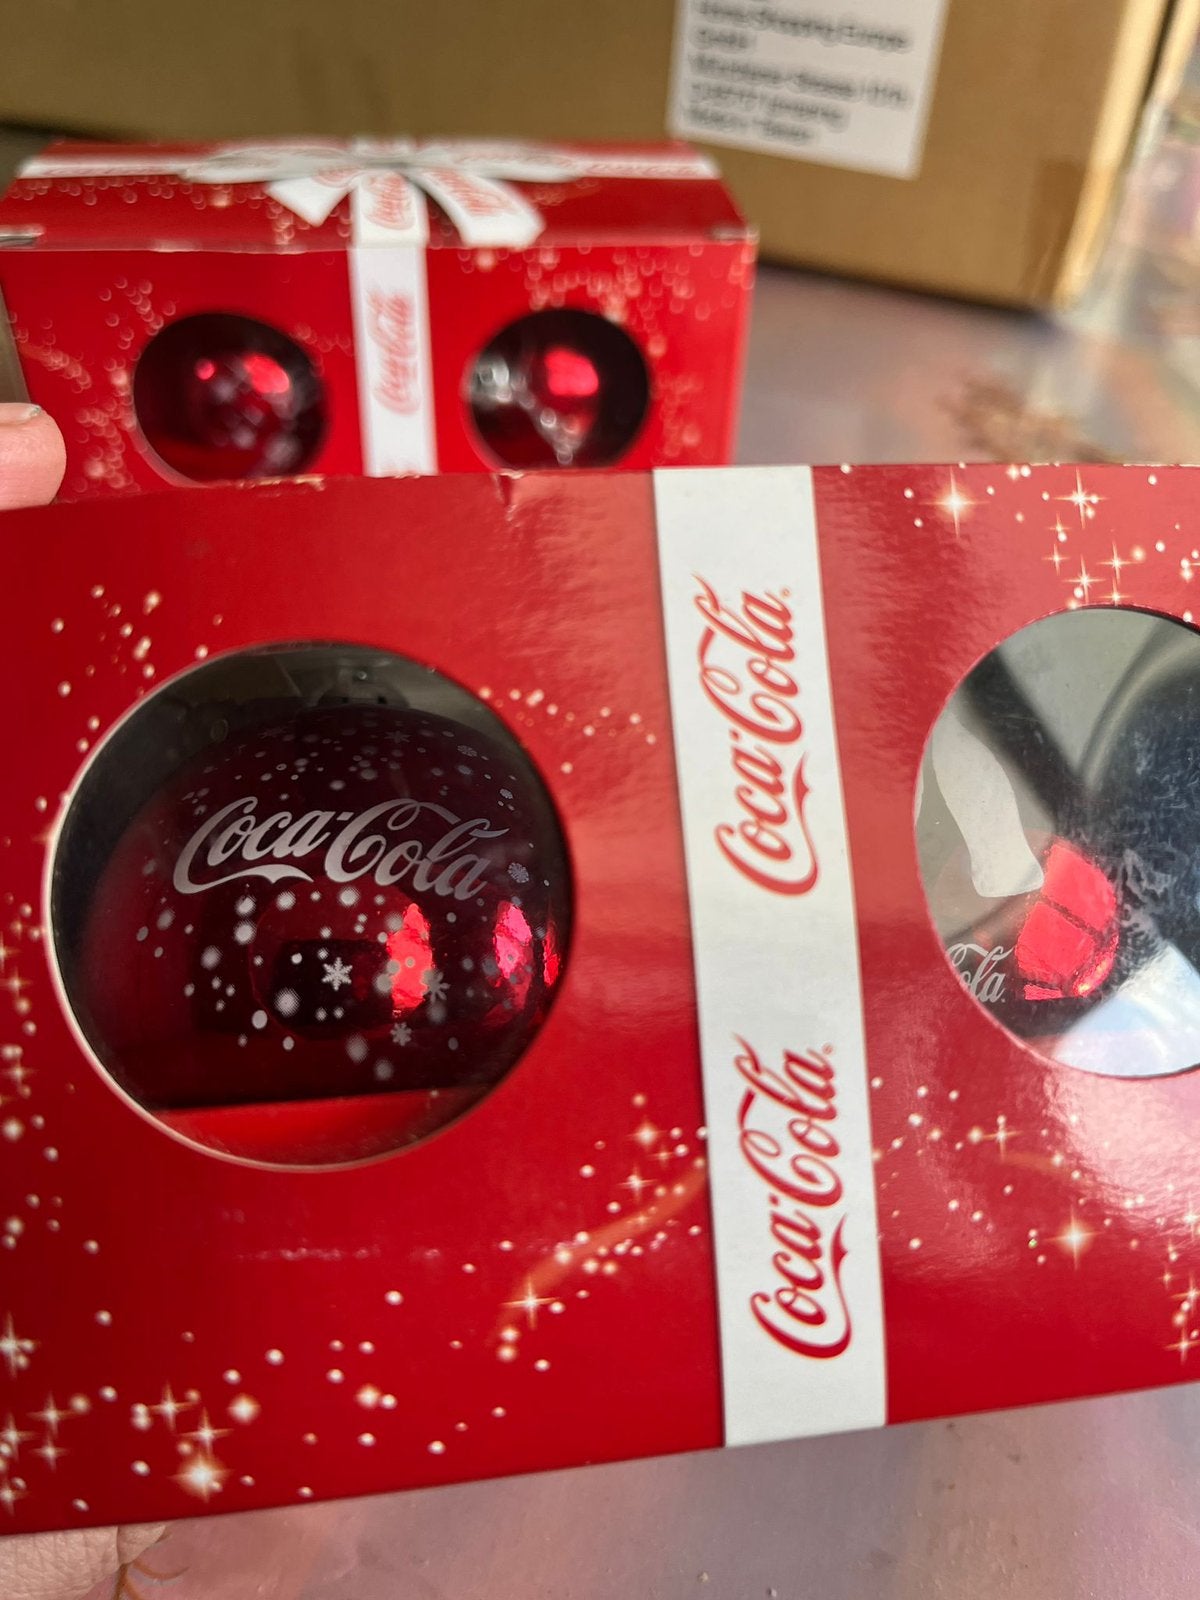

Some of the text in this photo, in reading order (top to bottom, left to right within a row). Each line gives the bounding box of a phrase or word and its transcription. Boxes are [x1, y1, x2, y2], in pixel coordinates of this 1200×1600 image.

[173, 796, 510, 900] Coca-Cola
[692, 572, 819, 897] Coca-Cola
[732, 1031, 852, 1360] Coca-Cola
